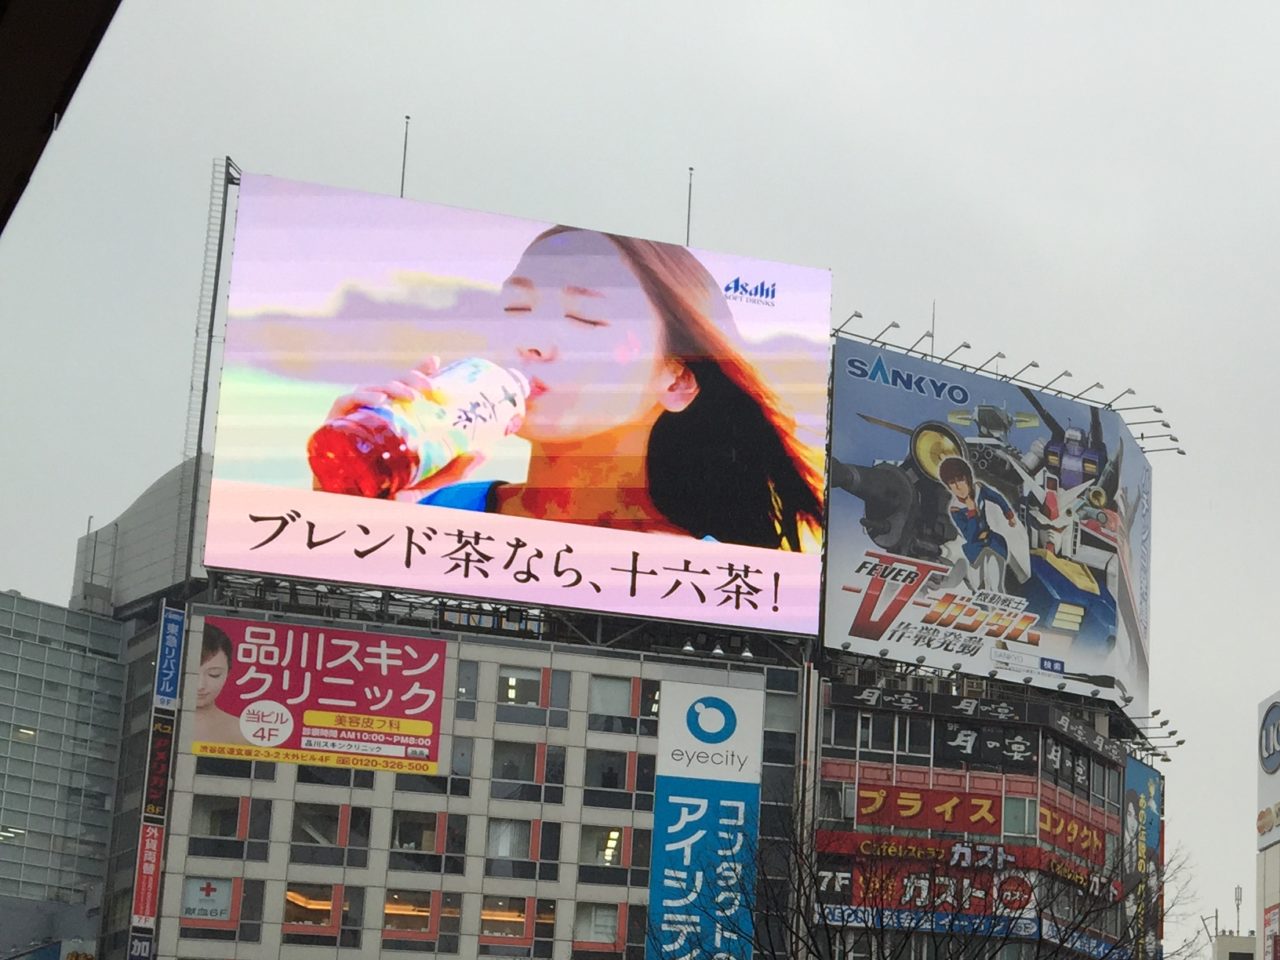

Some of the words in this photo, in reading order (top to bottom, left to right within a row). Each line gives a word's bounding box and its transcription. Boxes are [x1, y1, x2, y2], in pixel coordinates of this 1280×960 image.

[724, 276, 776, 300] Asahi
[847, 354, 969, 404] SANKYO
[855, 561, 919, 584] FEVER
[921, 592, 1041, 647] ガンダム
[237, 626, 440, 677] 品川スキン
[236, 665, 437, 716] クリニック
[245, 709, 289, 725] 当ビル
[334, 714, 401, 732] 美容皮フ科
[252, 727, 279, 742] 4F
[304, 740, 383, 754] 品川スキンクリニック
[671, 748, 749, 772] eyecity
[858, 789, 996, 825] プライス
[1039, 805, 1102, 852] コンタクト
[951, 841, 1016, 870] ガスト
[817, 870, 852, 893] 7F
[901, 871, 987, 909] ガスト
